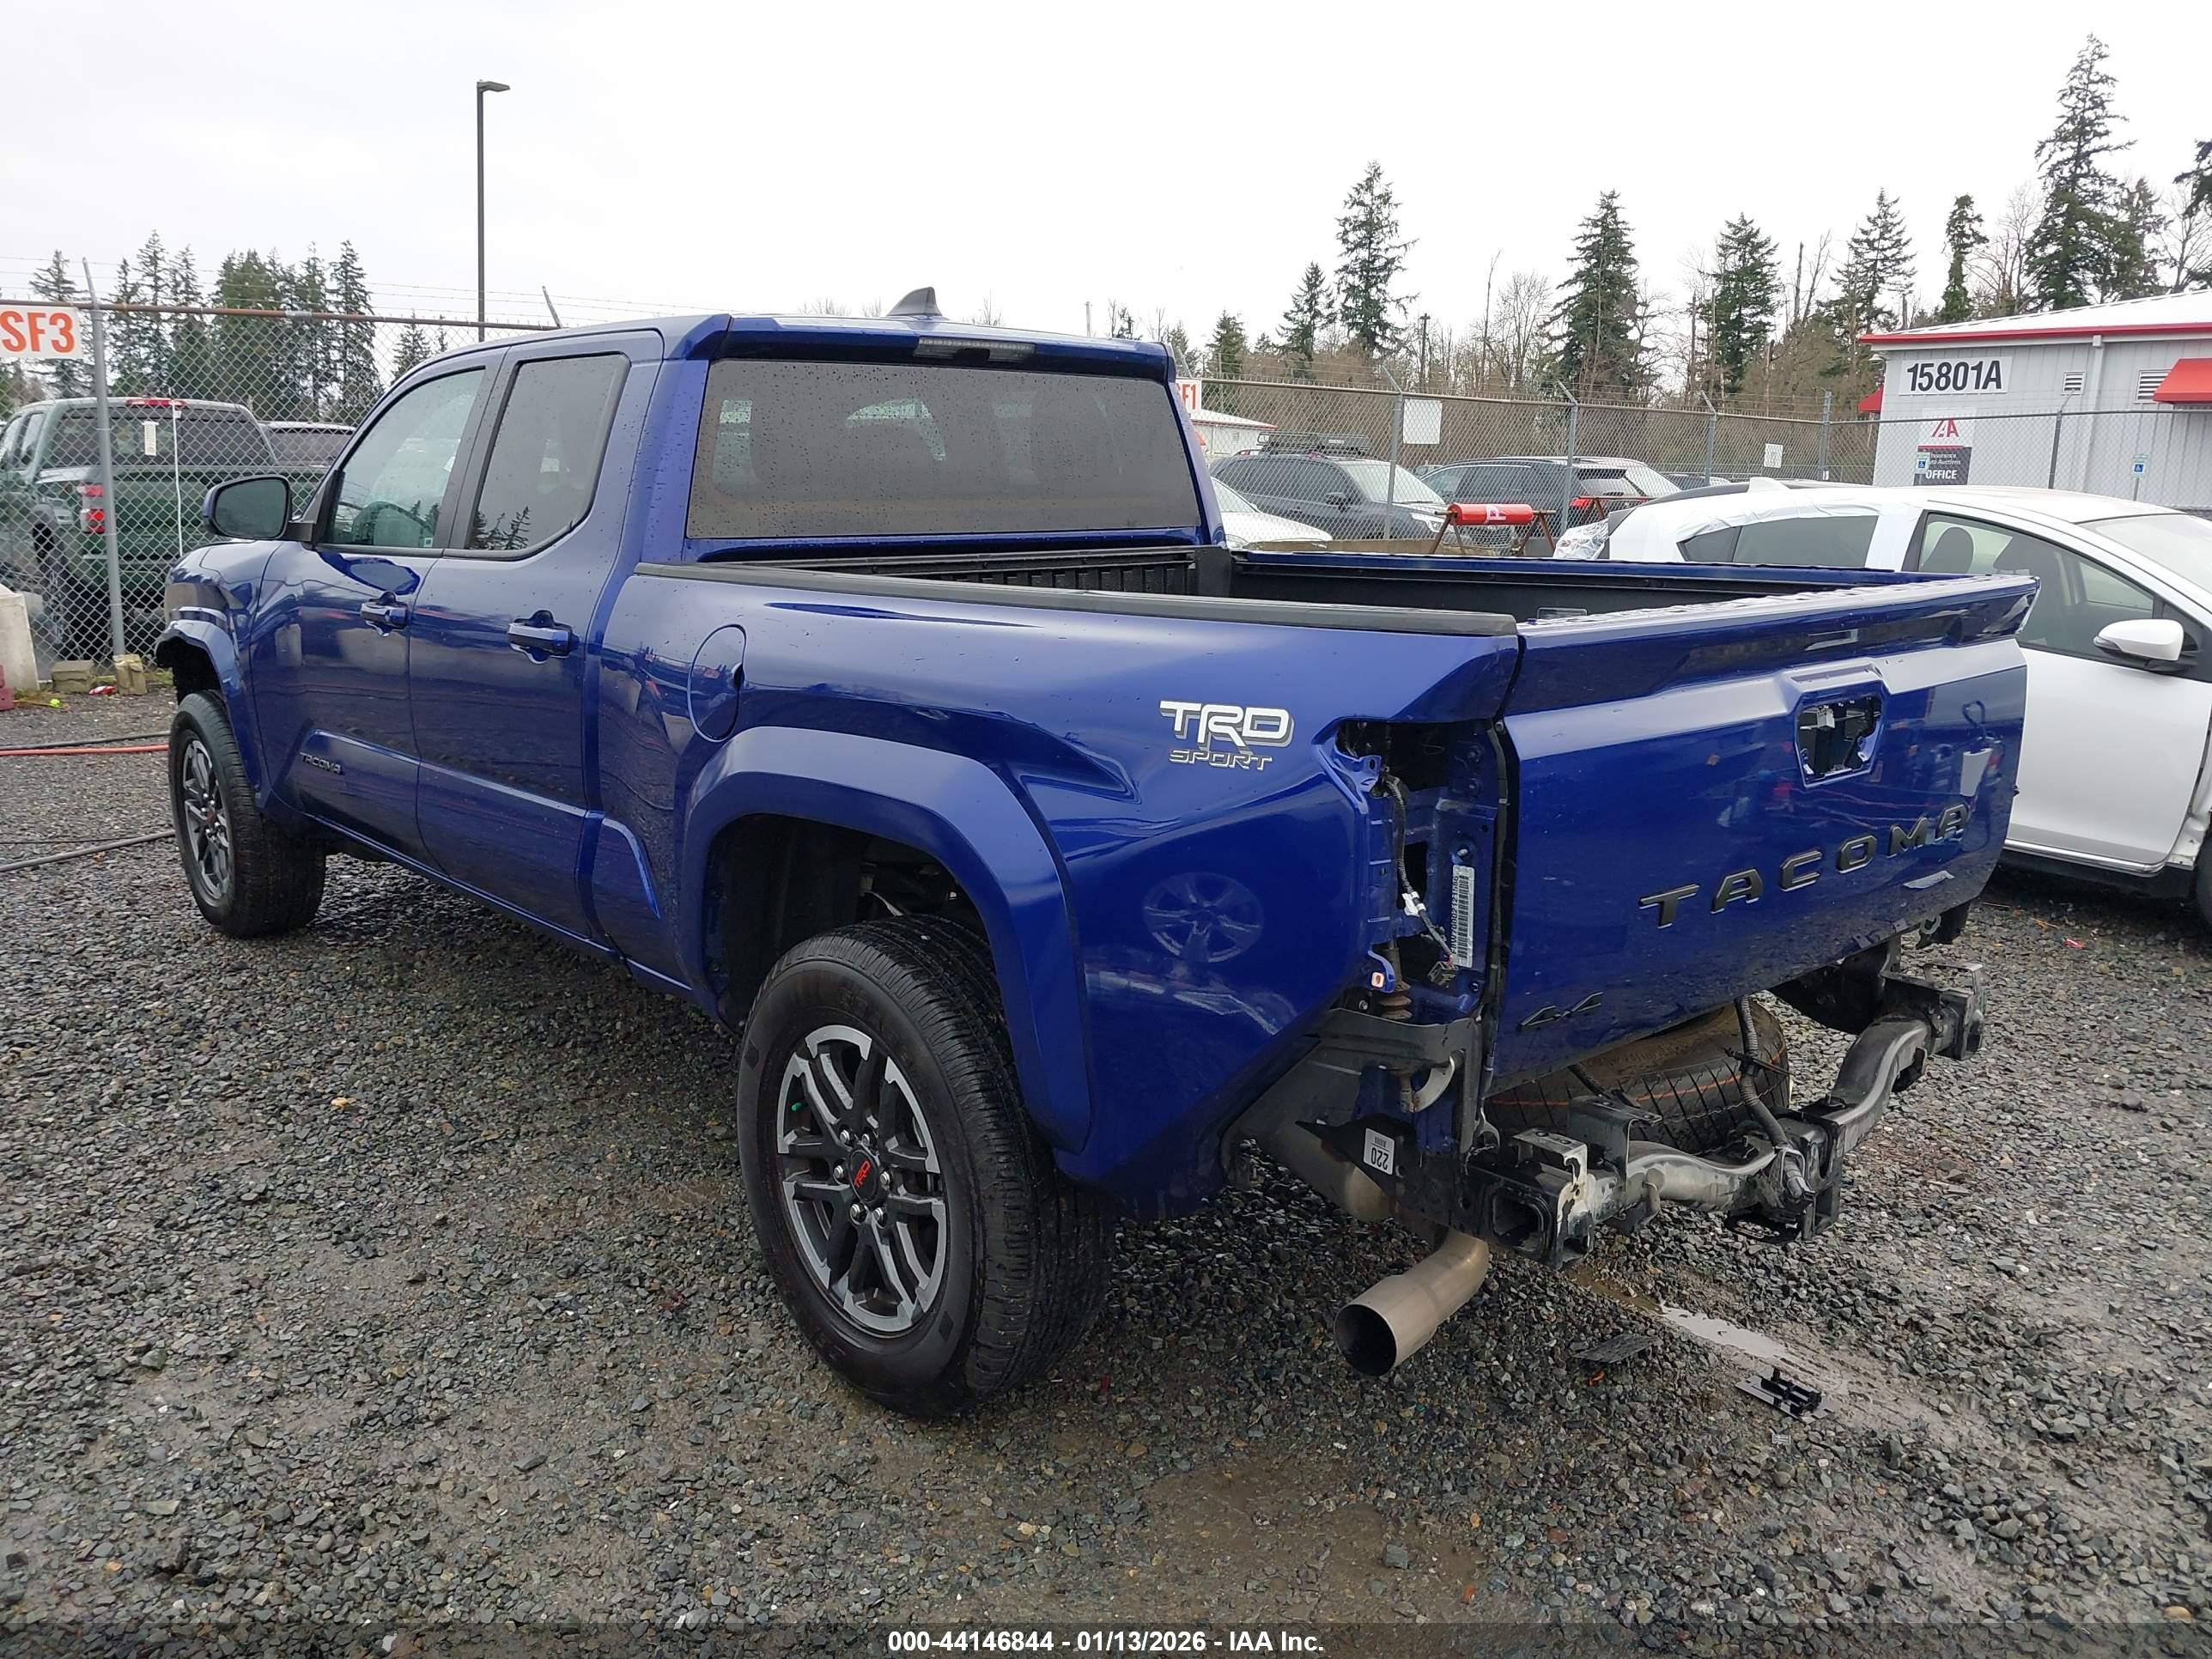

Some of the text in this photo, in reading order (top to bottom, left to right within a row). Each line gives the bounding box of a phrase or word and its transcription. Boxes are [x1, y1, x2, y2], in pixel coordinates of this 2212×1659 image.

[0, 310, 75, 353] SF3
[1906, 360, 2002, 392] 15801A
[1925, 469, 1958, 479] OFFICE
[1159, 701, 1291, 749] TRD
[300, 752, 343, 775] TACOMA
[1170, 749, 1273, 771] SPORT
[1638, 803, 1972, 929] TACOMA
[1370, 1147, 1389, 1170] 220
[854, 1159, 872, 1188] TRD
